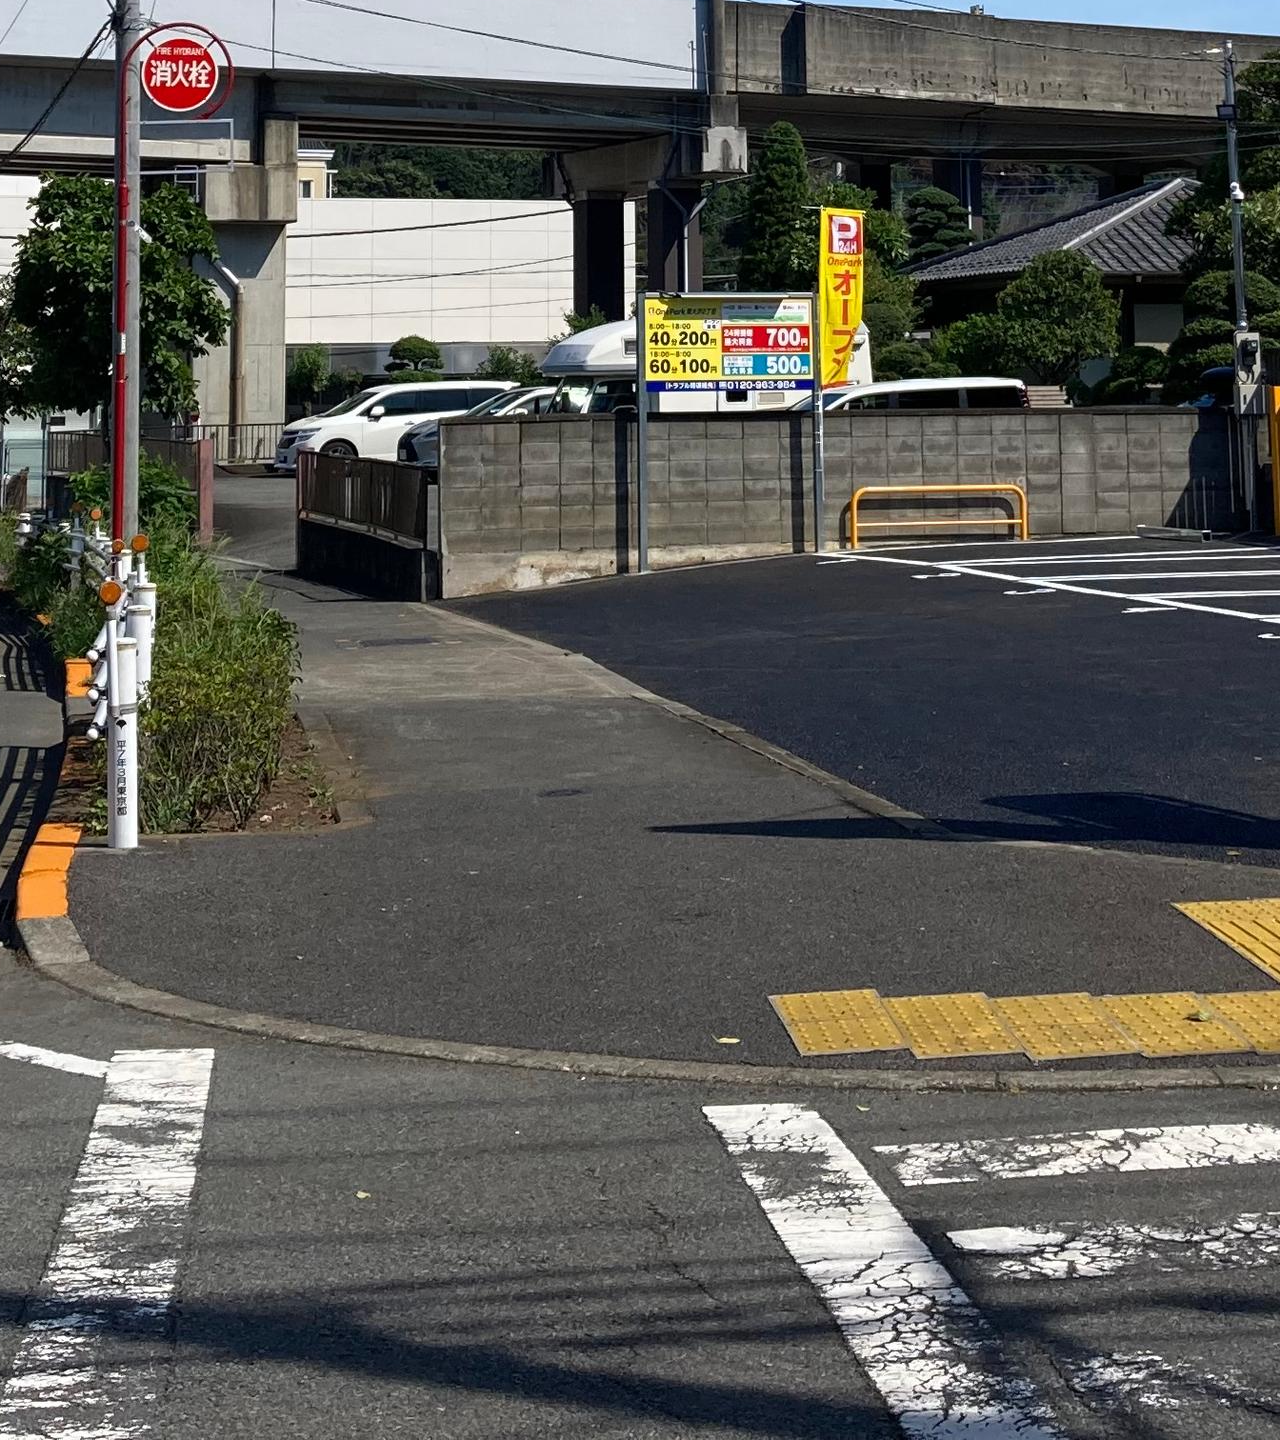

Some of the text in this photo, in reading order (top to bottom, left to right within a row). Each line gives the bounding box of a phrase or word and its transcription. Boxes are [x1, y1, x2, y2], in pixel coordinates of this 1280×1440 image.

[156, 46, 205, 56] FIRE HYDRANT
[149, 59, 212, 88] 消火栓
[838, 240, 858, 254] 24H
[827, 256, 862, 266] OnePark
